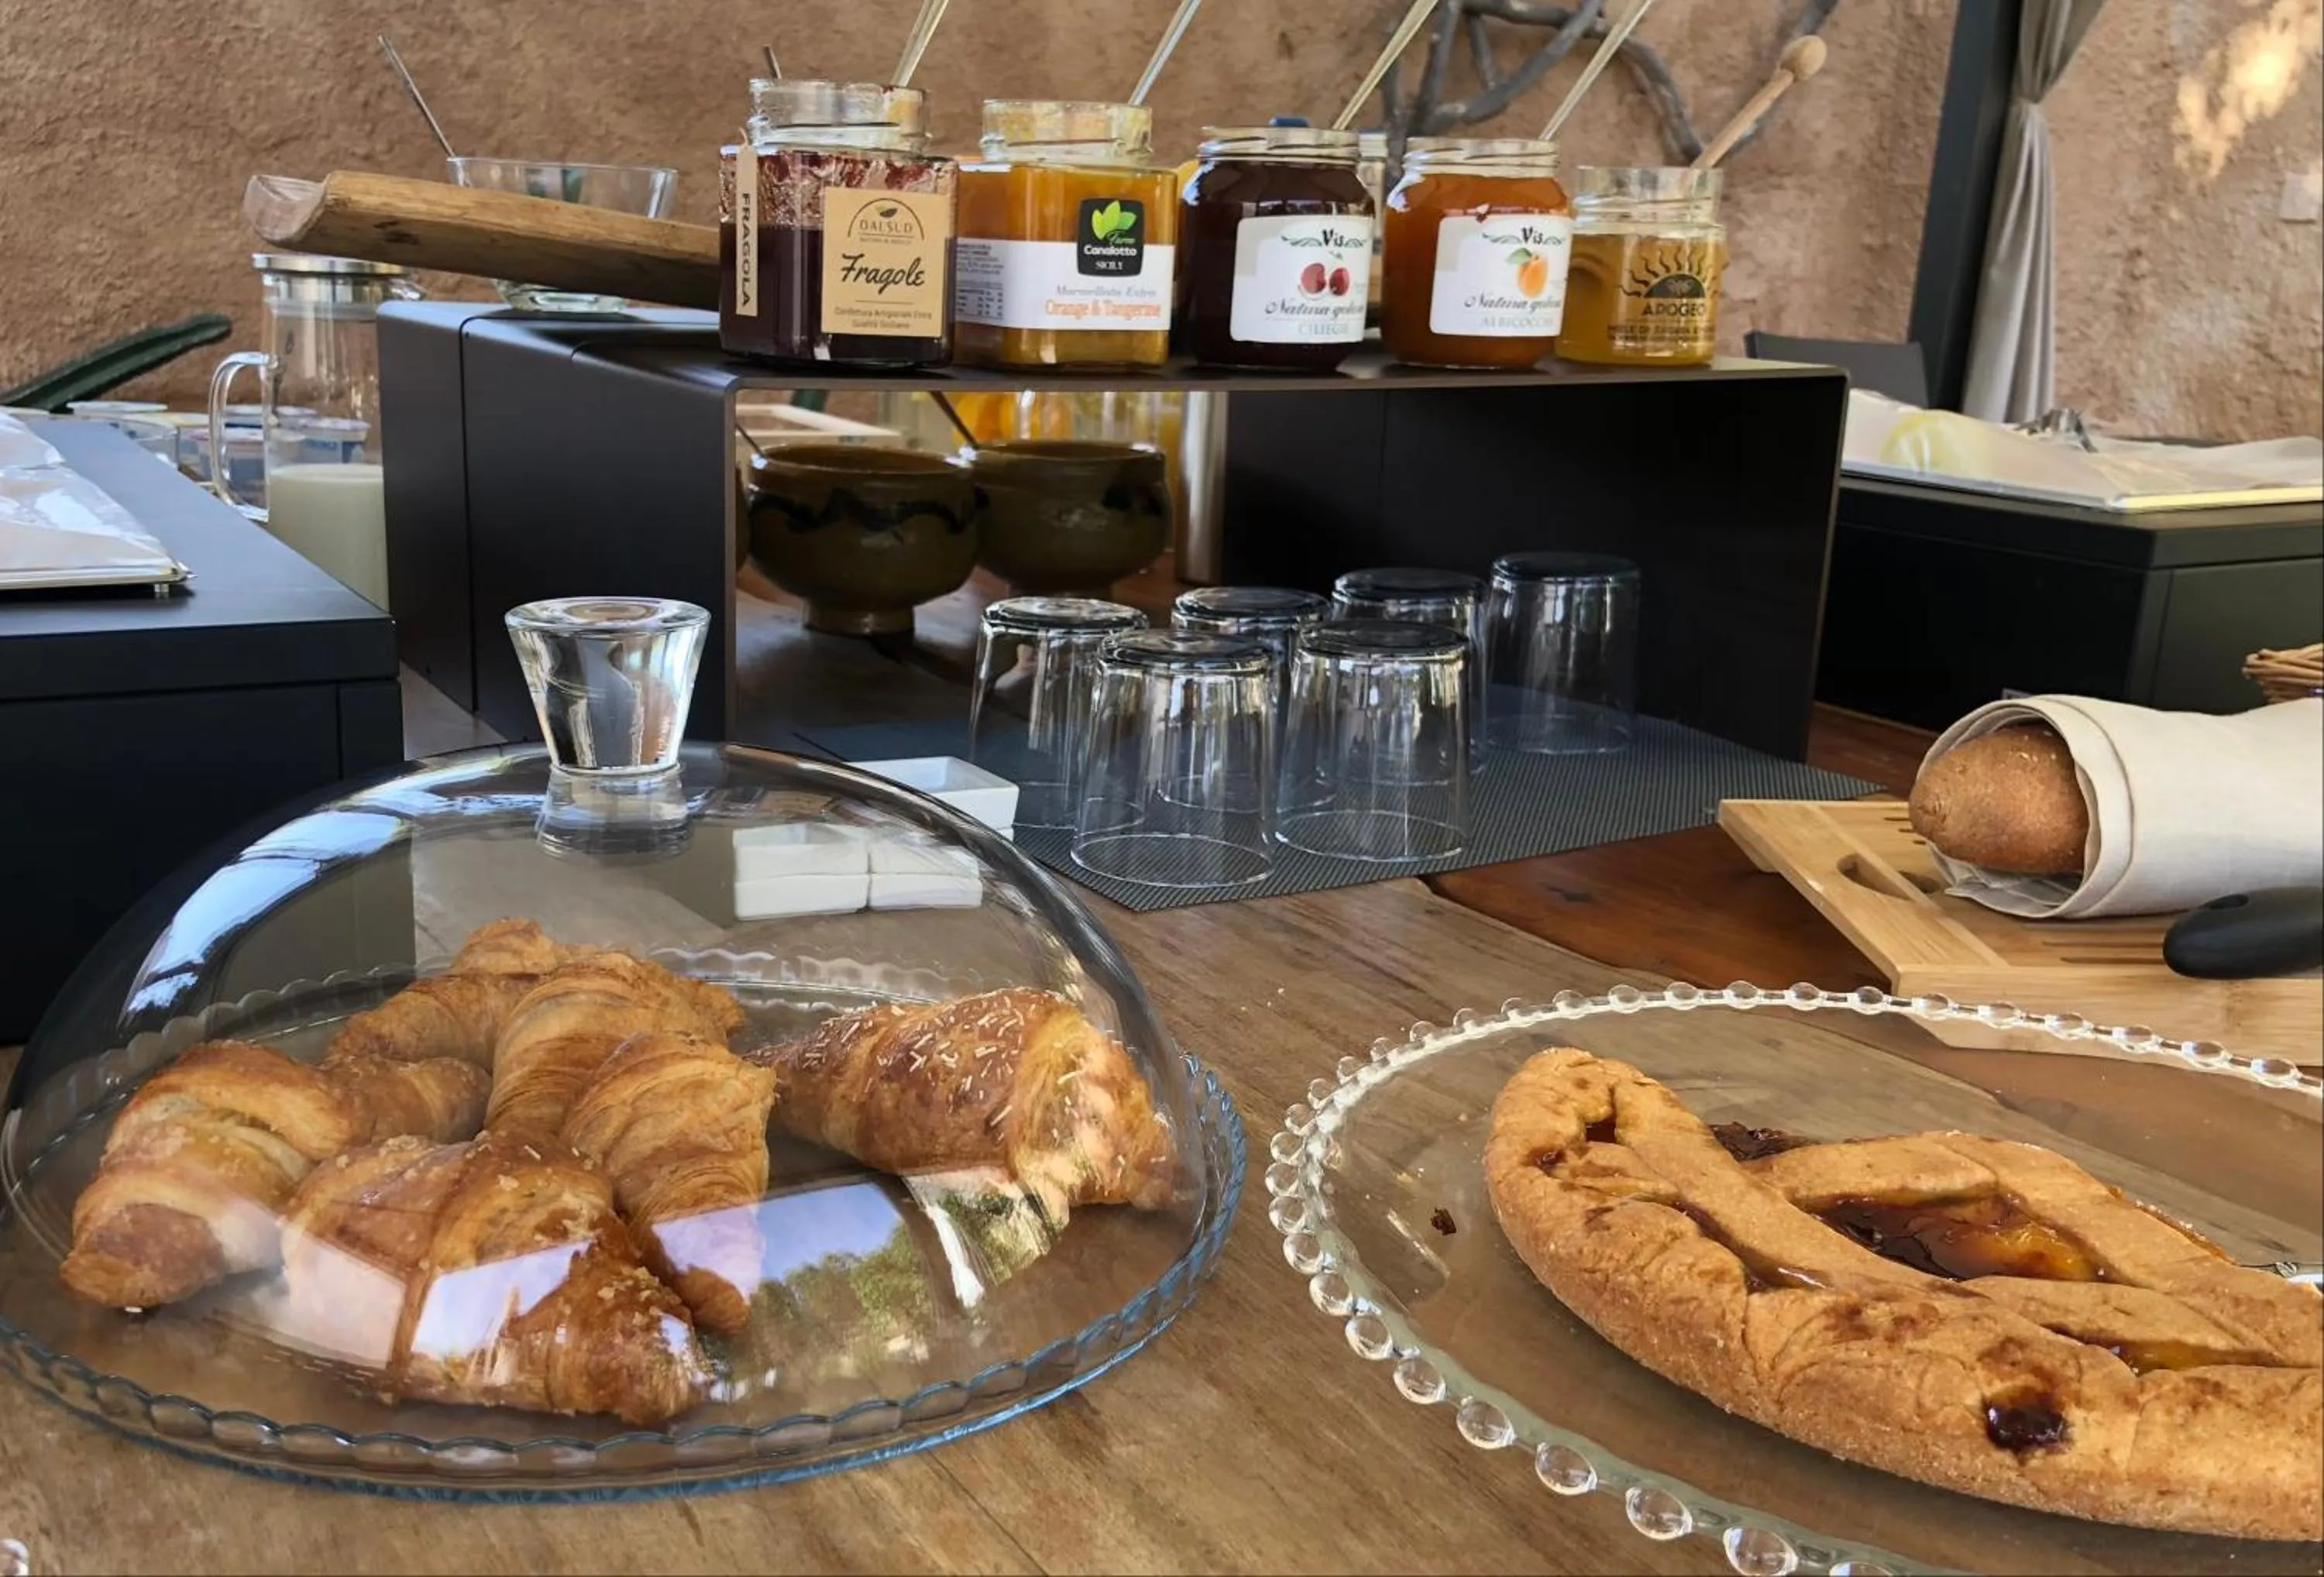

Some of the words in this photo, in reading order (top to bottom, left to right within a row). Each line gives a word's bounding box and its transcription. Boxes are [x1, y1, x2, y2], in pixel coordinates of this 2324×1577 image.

[741, 193, 751, 307] FRAGOLA
[1322, 228, 1344, 248] Vis
[1521, 226, 1544, 245] Vis
[841, 253, 925, 295] Fragole
